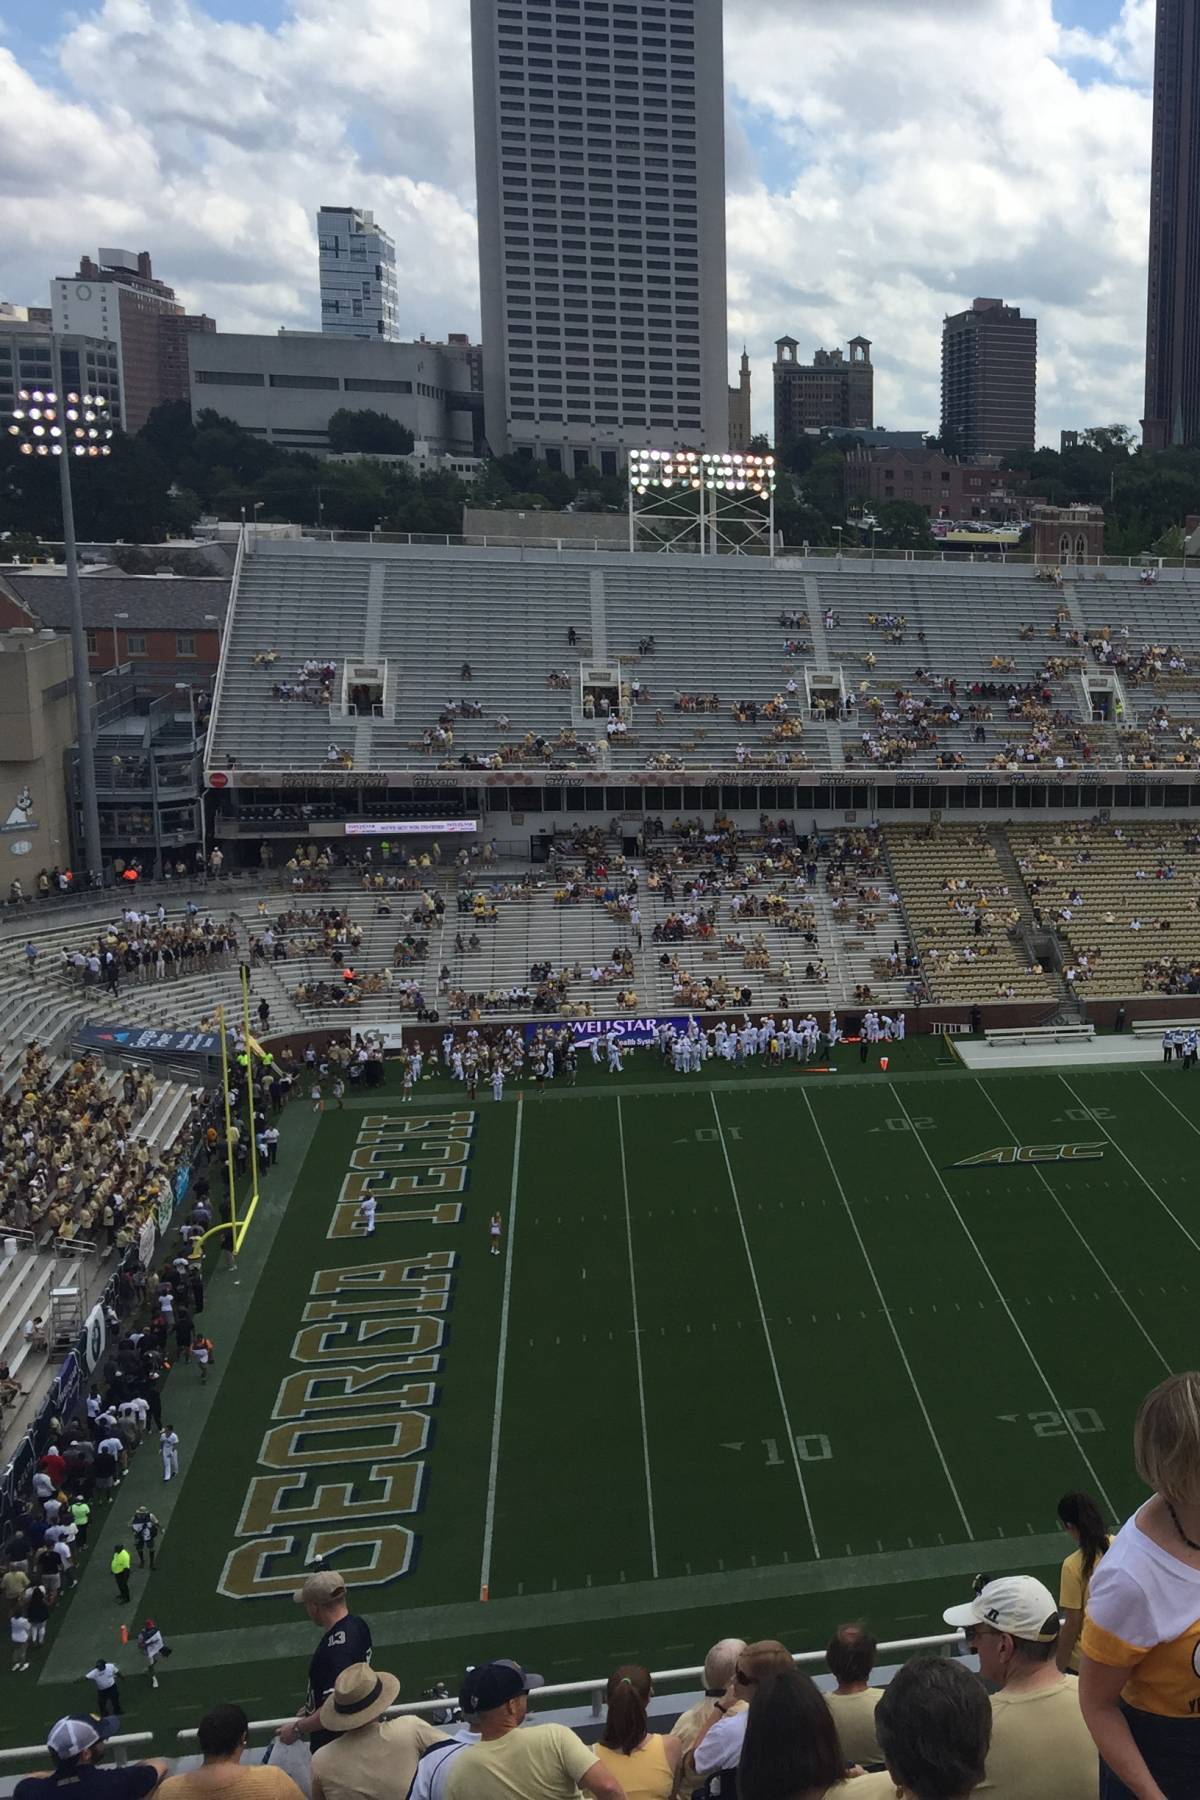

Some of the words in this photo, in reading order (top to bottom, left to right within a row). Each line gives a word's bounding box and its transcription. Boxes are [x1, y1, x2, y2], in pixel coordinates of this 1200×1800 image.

[347, 778, 389, 788] FAME
[571, 1018, 657, 1036] WELLSTAR
[617, 1039, 638, 1051] ealth
[640, 1039, 656, 1050] Syste
[1064, 1107, 1117, 1121] 30
[885, 1116, 937, 1131] 20
[694, 1126, 743, 1142] 10
[952, 1140, 1110, 1164] ACC
[326, 1110, 476, 1239] TECH
[216, 1250, 457, 1602] GEORGIA
[1027, 1407, 1107, 1438] 20
[760, 1433, 835, 1466] 10
[327, 1630, 347, 1648] 13
